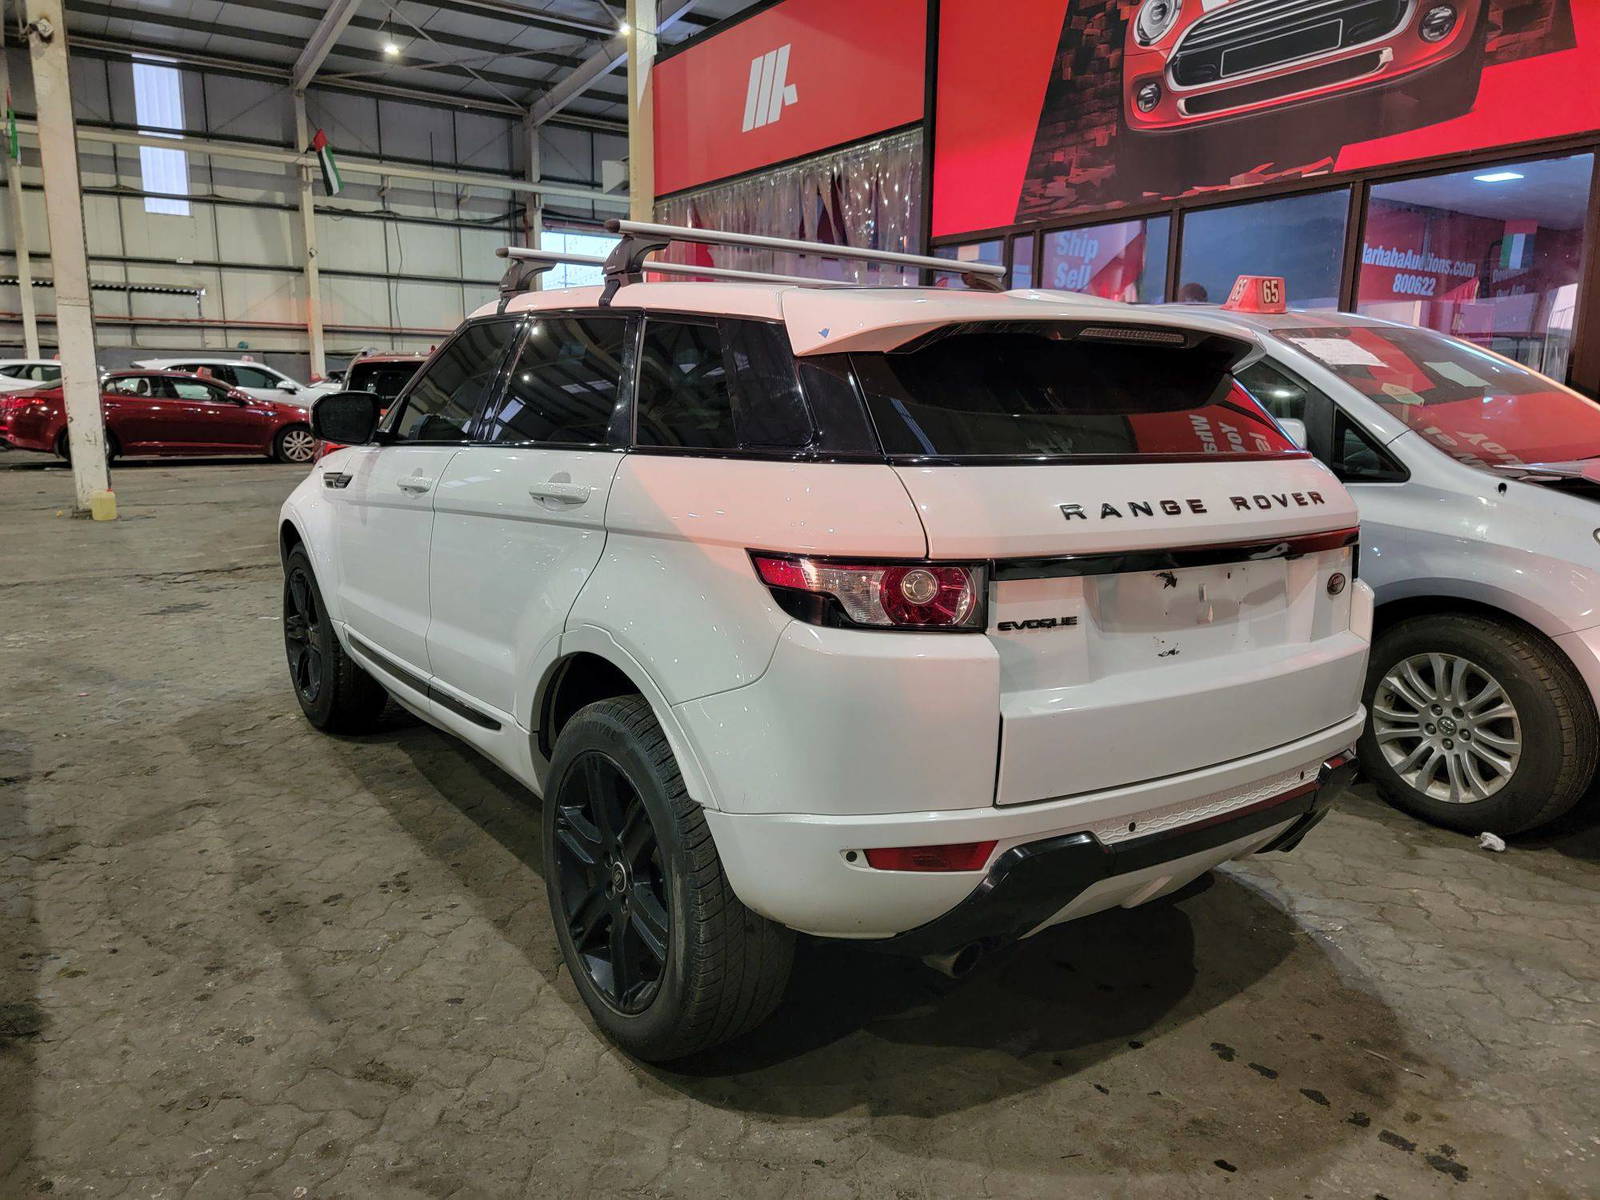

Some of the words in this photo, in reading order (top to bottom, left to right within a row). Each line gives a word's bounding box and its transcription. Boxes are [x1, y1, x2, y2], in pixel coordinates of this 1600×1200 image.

[1056, 231, 1098, 263] Ship
[1362, 243, 1476, 277] arhabaAuctions.com
[1054, 262, 1093, 290] Sell
[1392, 273, 1437, 296] 800622
[1263, 279, 1279, 303] 65
[1057, 498, 1207, 520] RANGE
[1229, 491, 1326, 511] ROVER
[998, 616, 1077, 631] EVOQUE
